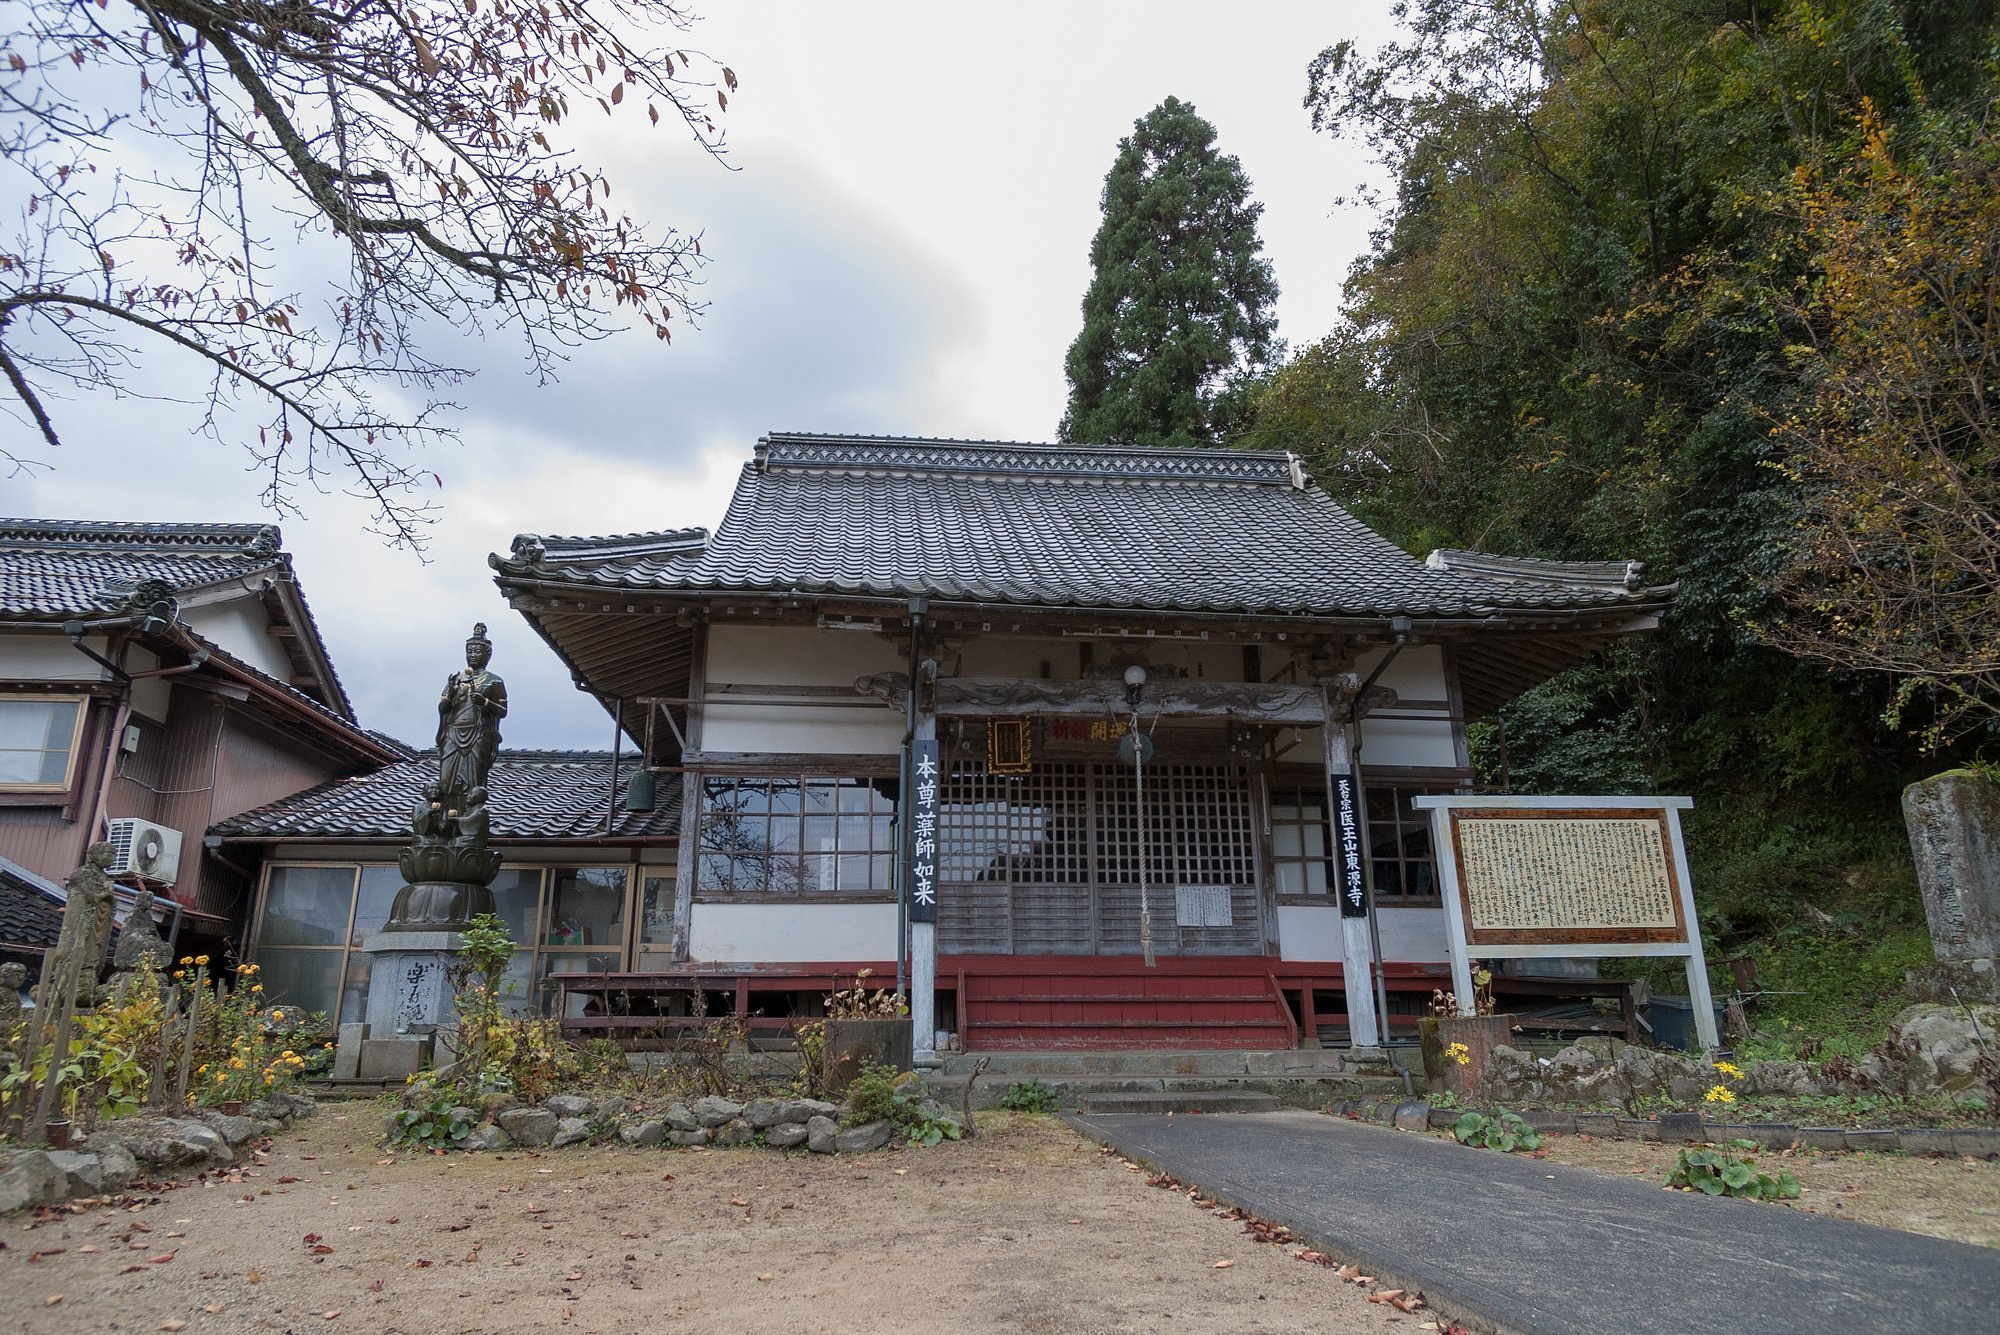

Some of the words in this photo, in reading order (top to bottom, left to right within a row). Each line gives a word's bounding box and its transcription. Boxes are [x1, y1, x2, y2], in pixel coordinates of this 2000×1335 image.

[914, 754, 938, 906] 本尊薬師如来
[1338, 780, 1363, 907] 天台宗医王山東源寺
